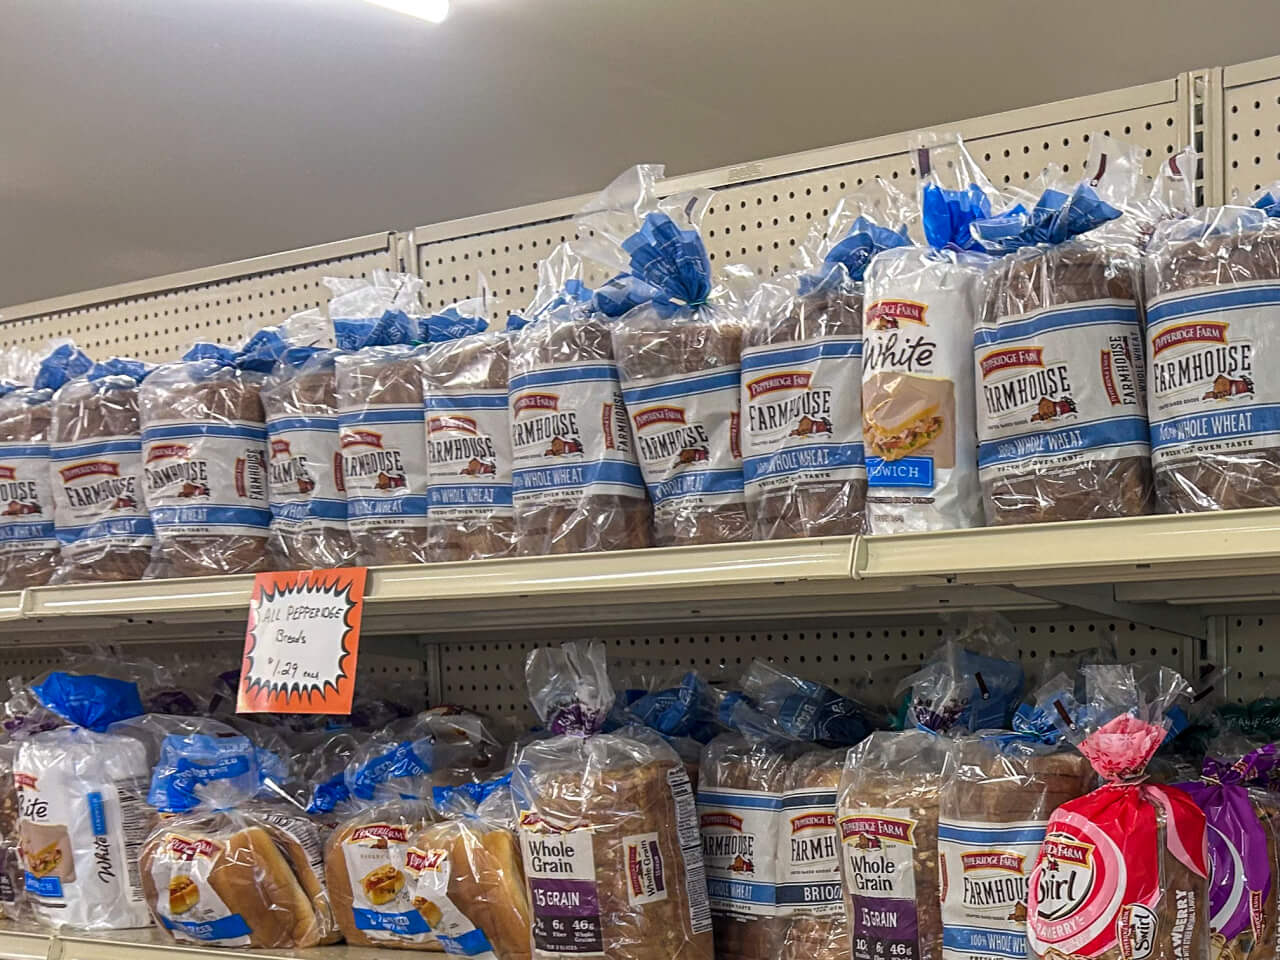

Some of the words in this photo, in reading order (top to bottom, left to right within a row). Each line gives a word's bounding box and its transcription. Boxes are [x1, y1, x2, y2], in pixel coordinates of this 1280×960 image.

[1196, 323, 1226, 339] FARM
[1153, 344, 1252, 393] FARMHOUSE
[1047, 430, 1084, 450] WHEAT
[524, 472, 551, 489] WHOLE
[553, 468, 583, 485] WHEAT
[287, 606, 344, 620] PEPPERIDGE
[276, 629, 306, 644] Breads
[877, 821, 904, 836] FARM
[528, 840, 574, 858] Whole
[95, 836, 115, 884] White
[532, 856, 573, 874] Grain
[850, 855, 895, 874] Whole
[854, 873, 893, 892] Grain
[547, 892, 580, 908] GRAIN
[870, 911, 897, 928] GRAIN
[988, 935, 1010, 950] WHOLE
